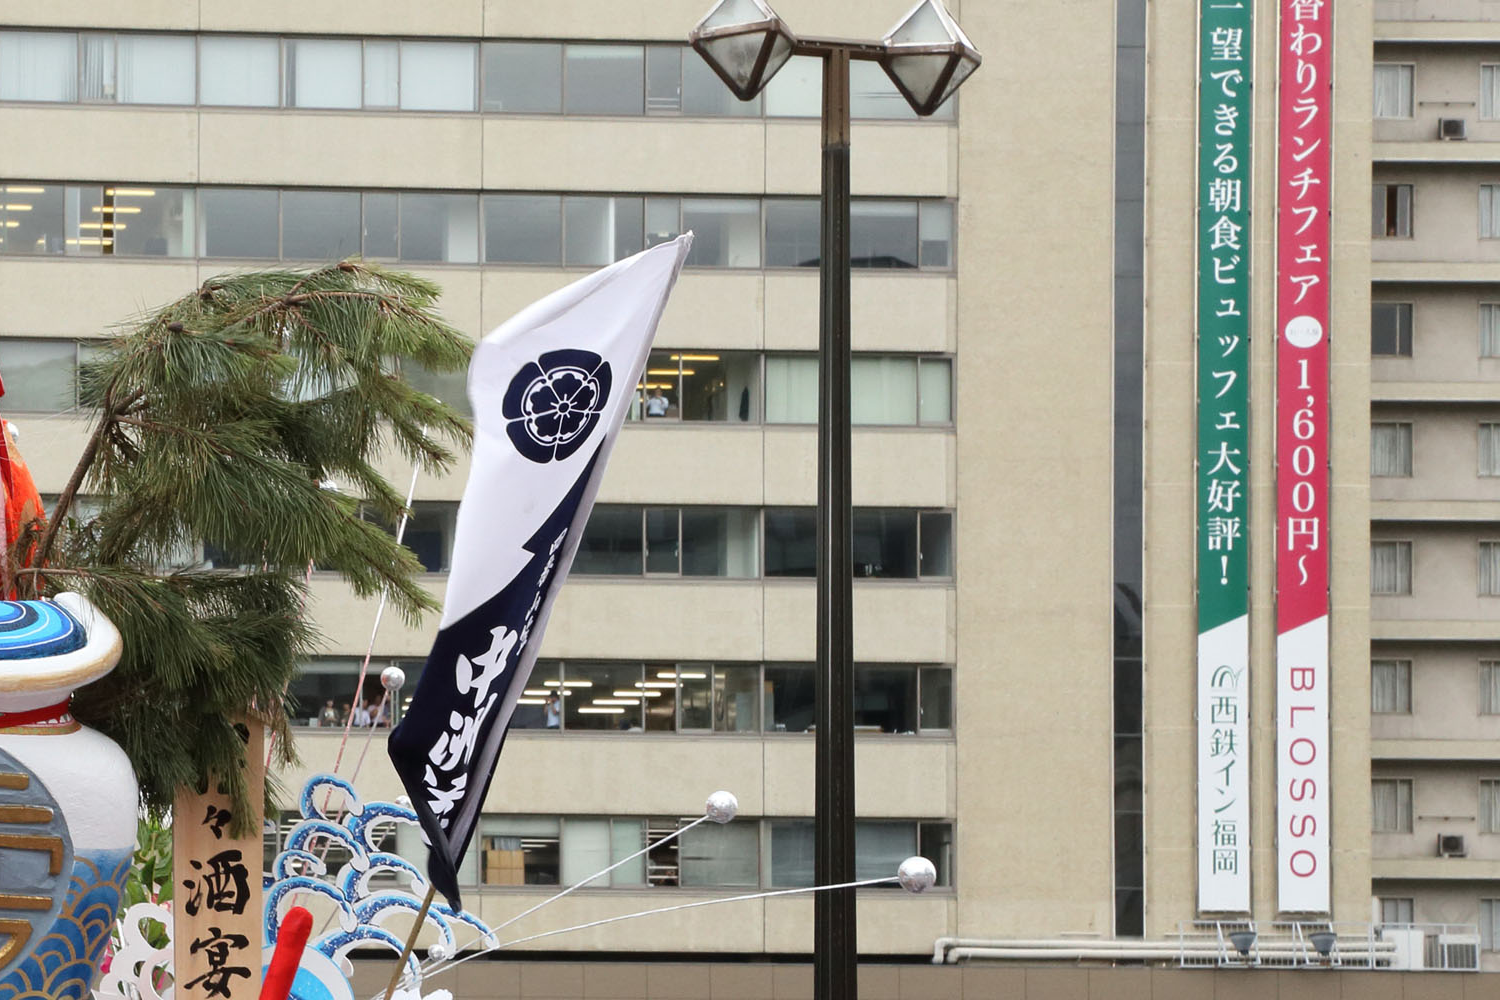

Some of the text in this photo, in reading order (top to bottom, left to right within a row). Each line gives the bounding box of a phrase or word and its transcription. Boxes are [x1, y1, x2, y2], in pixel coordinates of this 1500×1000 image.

[1209, 695, 1239, 876] 西鉄イン福岡
[1289, 666, 1317, 878] BLOSSO
